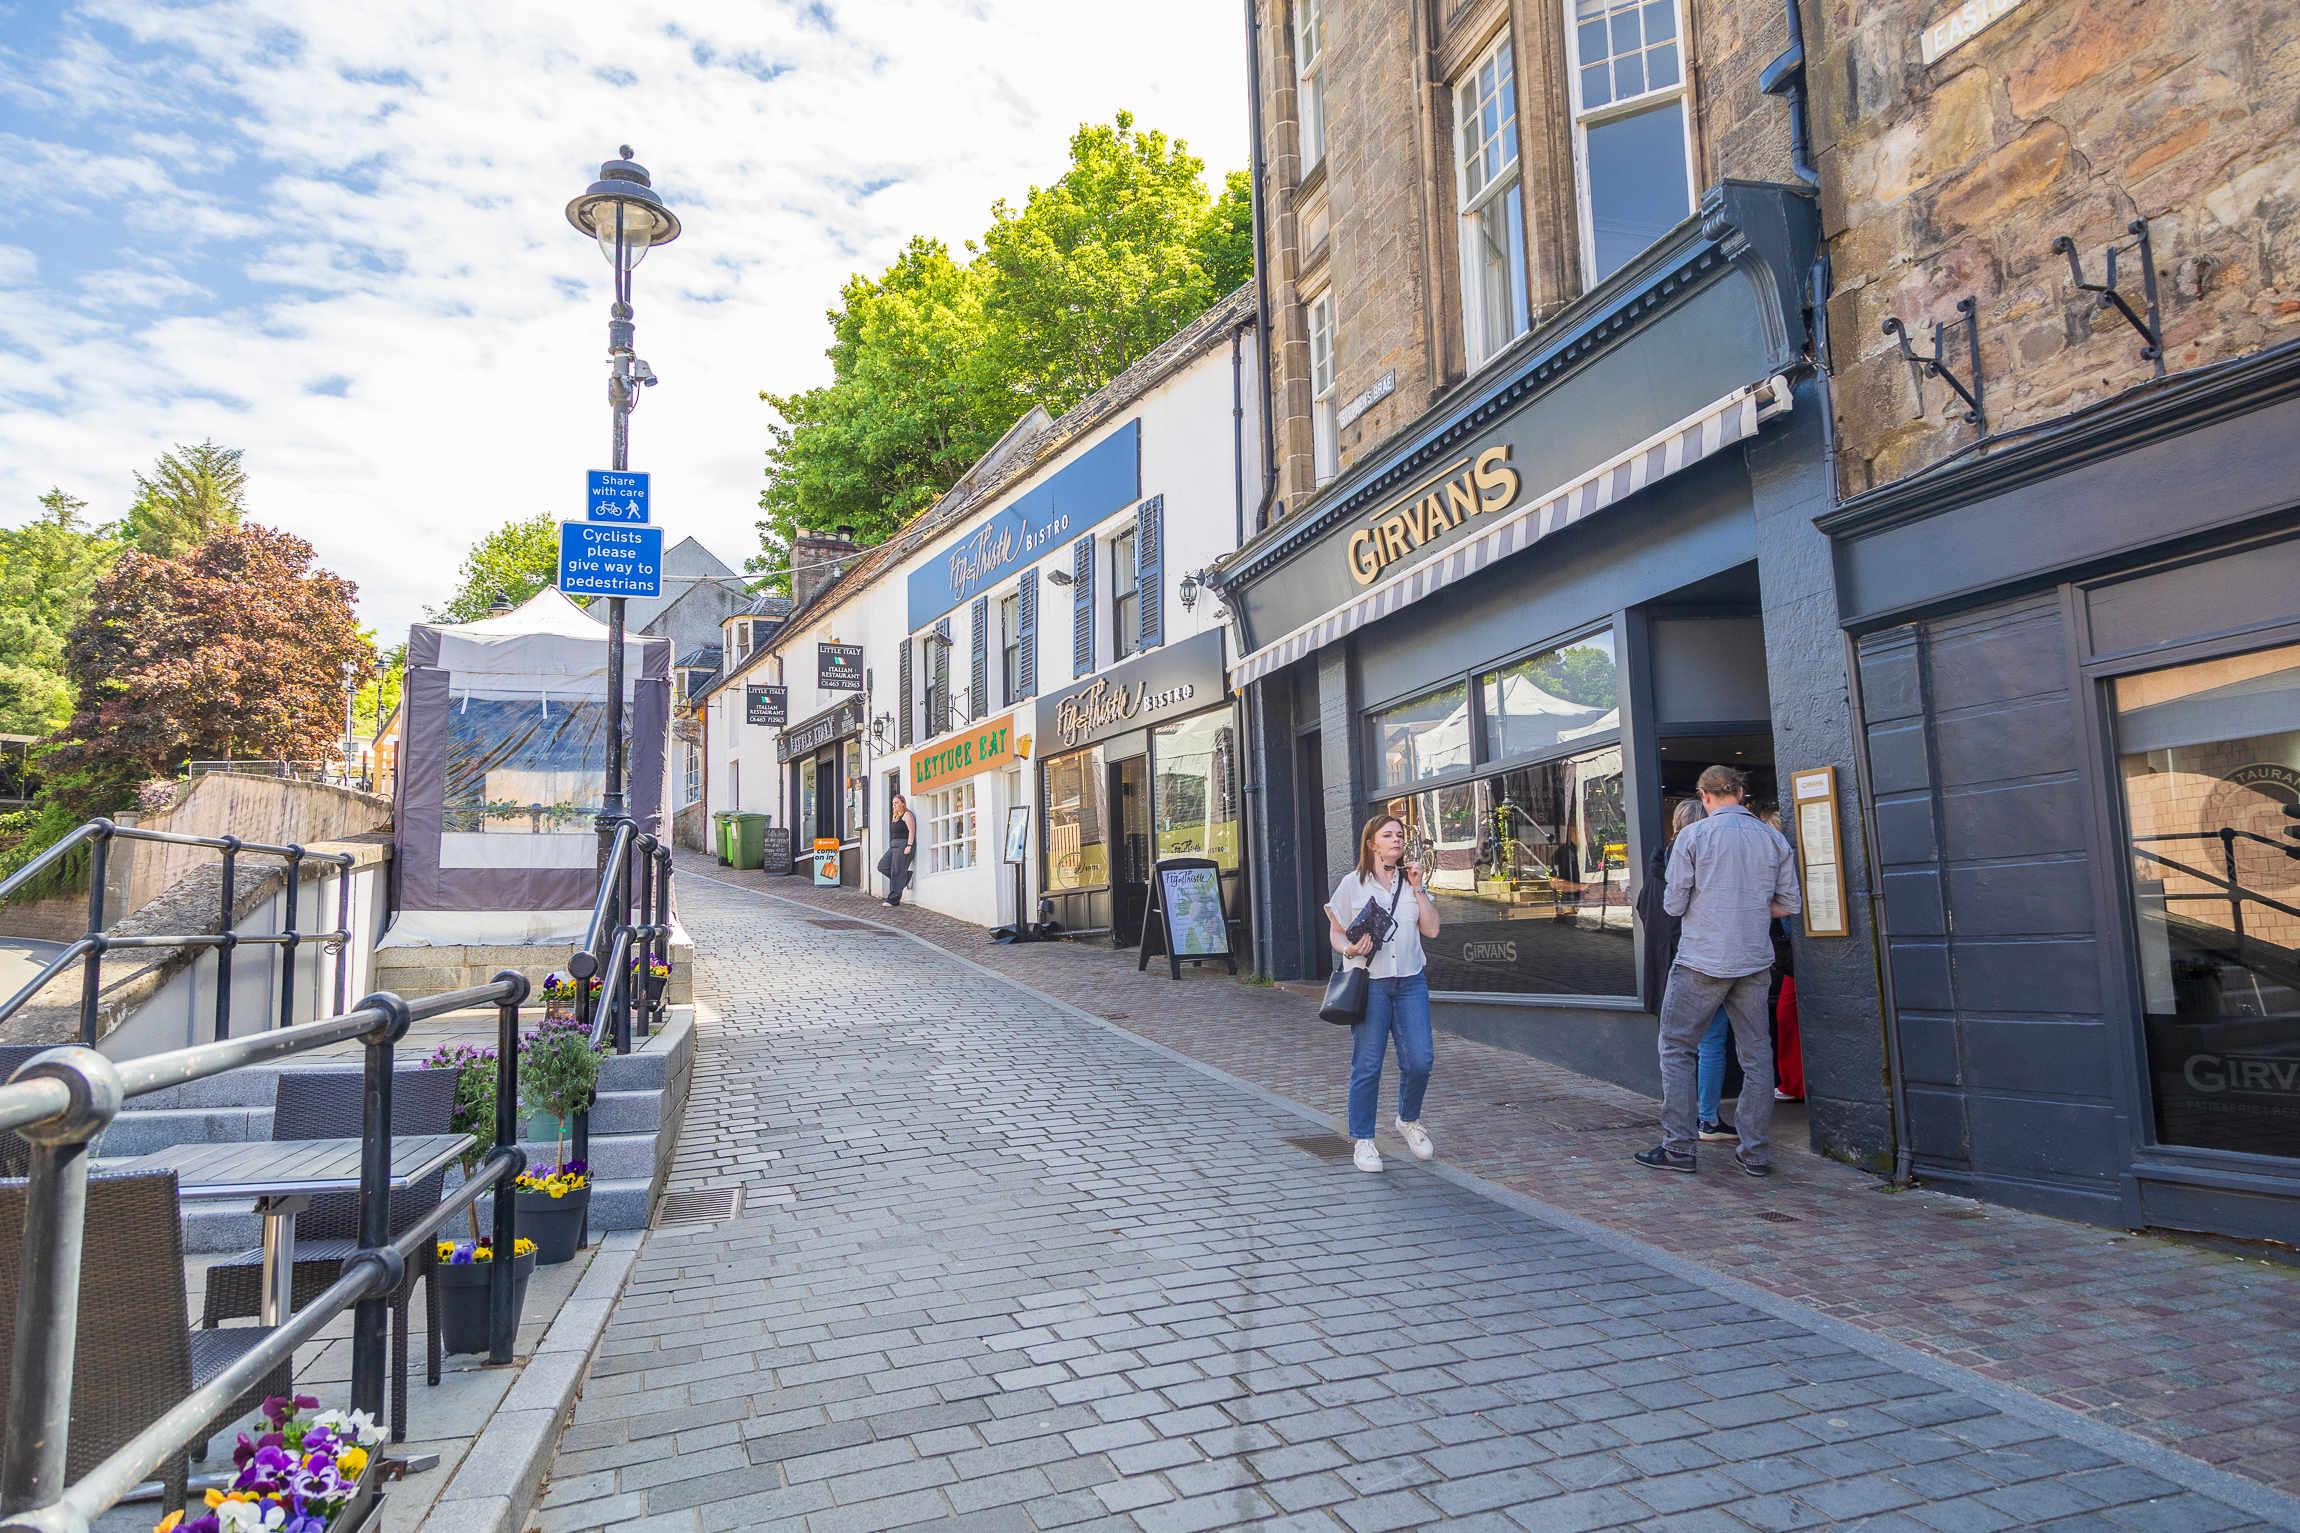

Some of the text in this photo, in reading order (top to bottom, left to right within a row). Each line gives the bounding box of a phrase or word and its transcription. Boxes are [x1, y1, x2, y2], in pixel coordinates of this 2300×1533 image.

[602, 475, 635, 486] Share
[592, 486, 645, 498] with care
[1348, 445, 1519, 585] GIRVANS
[583, 528, 642, 543] Cyclists
[1026, 514, 1069, 551] BISTRO
[587, 545, 637, 558] please
[568, 558, 653, 575] give way to
[566, 576, 654, 591] pedestrians
[820, 645, 861, 656] LITTLE ITALY
[821, 671, 860, 679] RESTAURANT
[828, 666, 853, 674] ITALIAN
[1143, 684, 1194, 712] BISTRO
[917, 728, 1007, 783] LETTUCE EAT
[1463, 941, 1517, 961] GIRVANS
[2184, 1054, 2300, 1093] GIRV
